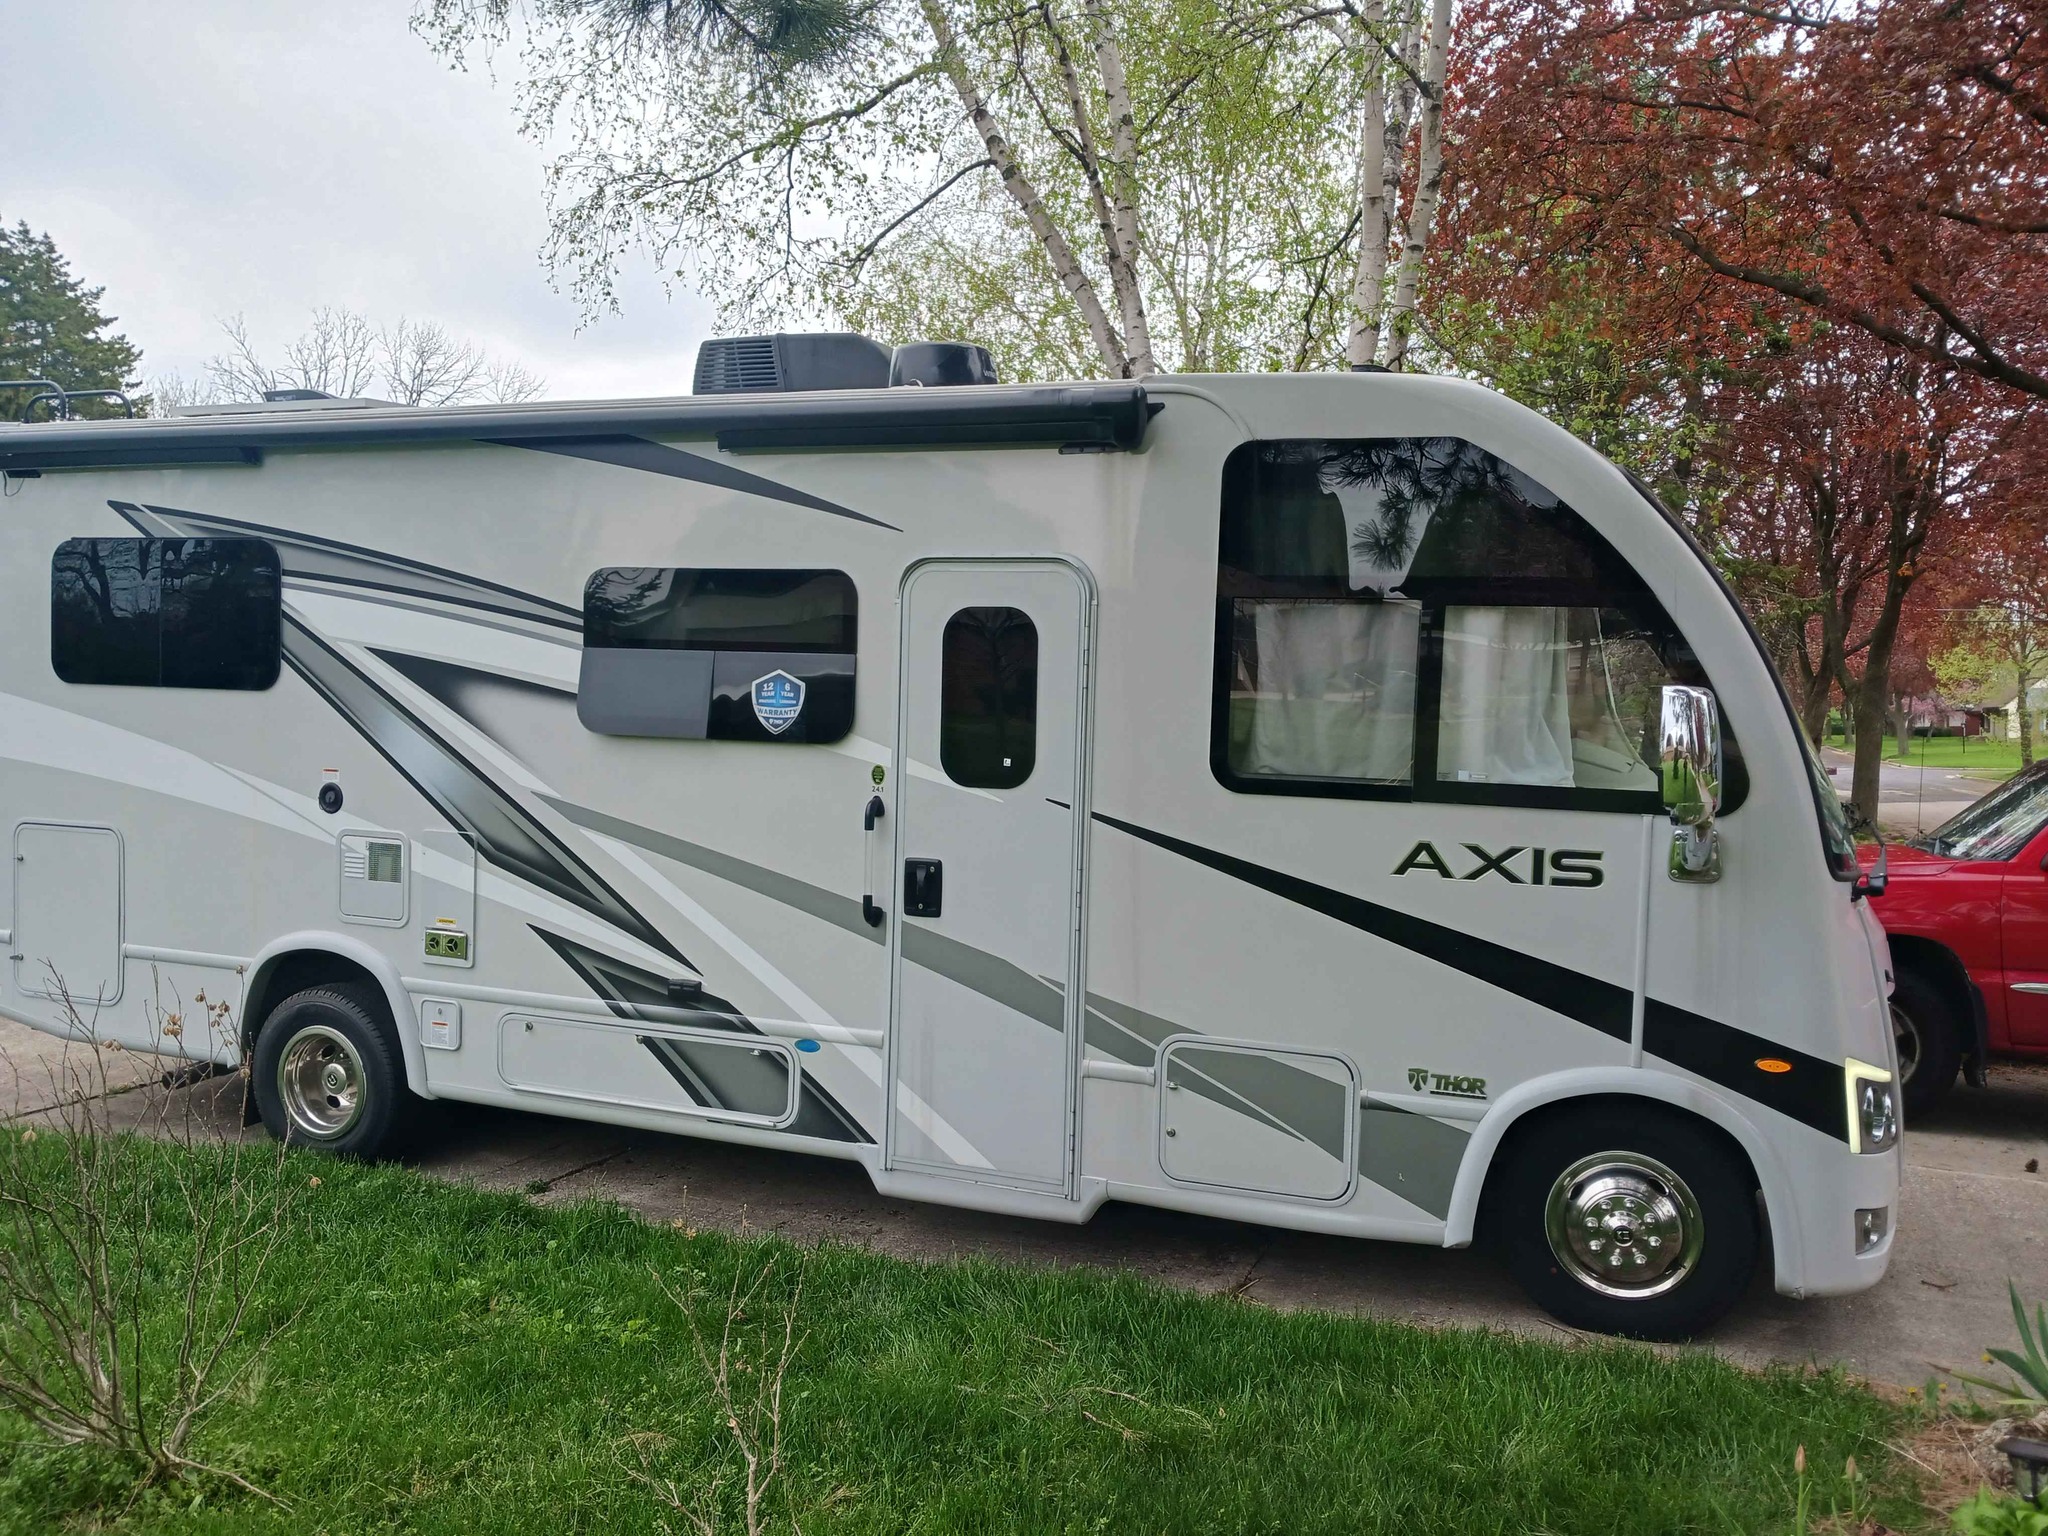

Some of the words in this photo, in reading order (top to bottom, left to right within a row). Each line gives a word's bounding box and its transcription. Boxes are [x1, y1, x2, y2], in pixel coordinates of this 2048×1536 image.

[763, 682, 774, 691] 12
[784, 683, 791, 691] 6
[757, 708, 797, 716] WARRANTY
[1389, 840, 1604, 889] AXIS
[1430, 1074, 1486, 1095] THOR
